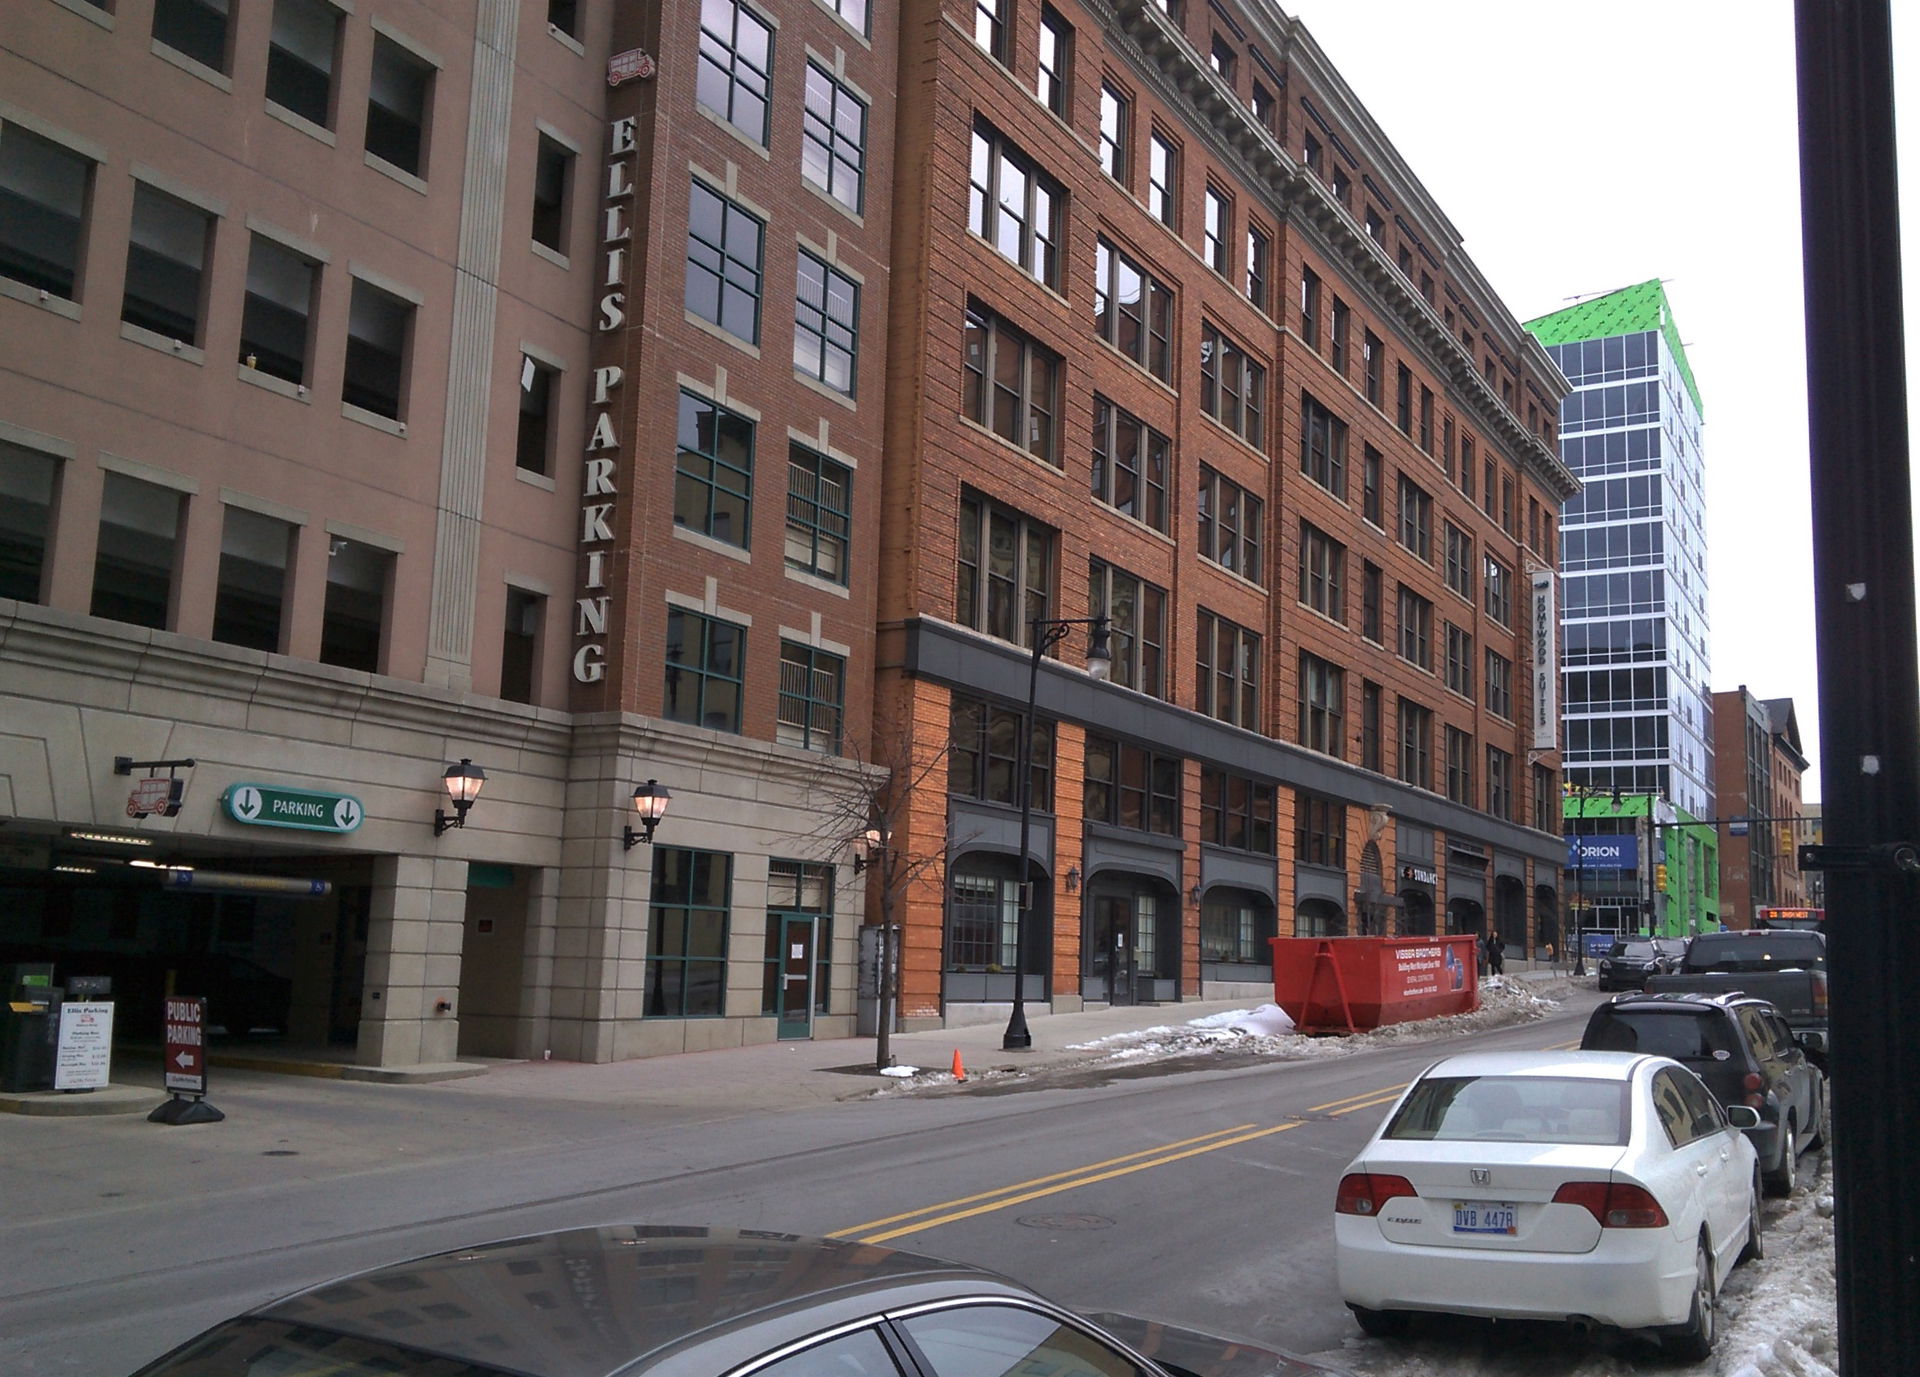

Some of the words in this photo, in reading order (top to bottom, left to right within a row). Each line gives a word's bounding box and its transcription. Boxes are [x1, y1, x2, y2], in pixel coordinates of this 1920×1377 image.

[599, 115, 638, 332] ELLIS
[573, 365, 624, 683] PARKING
[1537, 595, 1548, 666] HOMEWOOD
[1538, 672, 1546, 726] SUITES
[272, 799, 324, 818] PARKING
[1577, 846, 1620, 857] ORION
[167, 1001, 201, 1022] PUBLIC
[167, 1025, 202, 1046] PARKING
[1455, 1209, 1477, 1227] DVB
